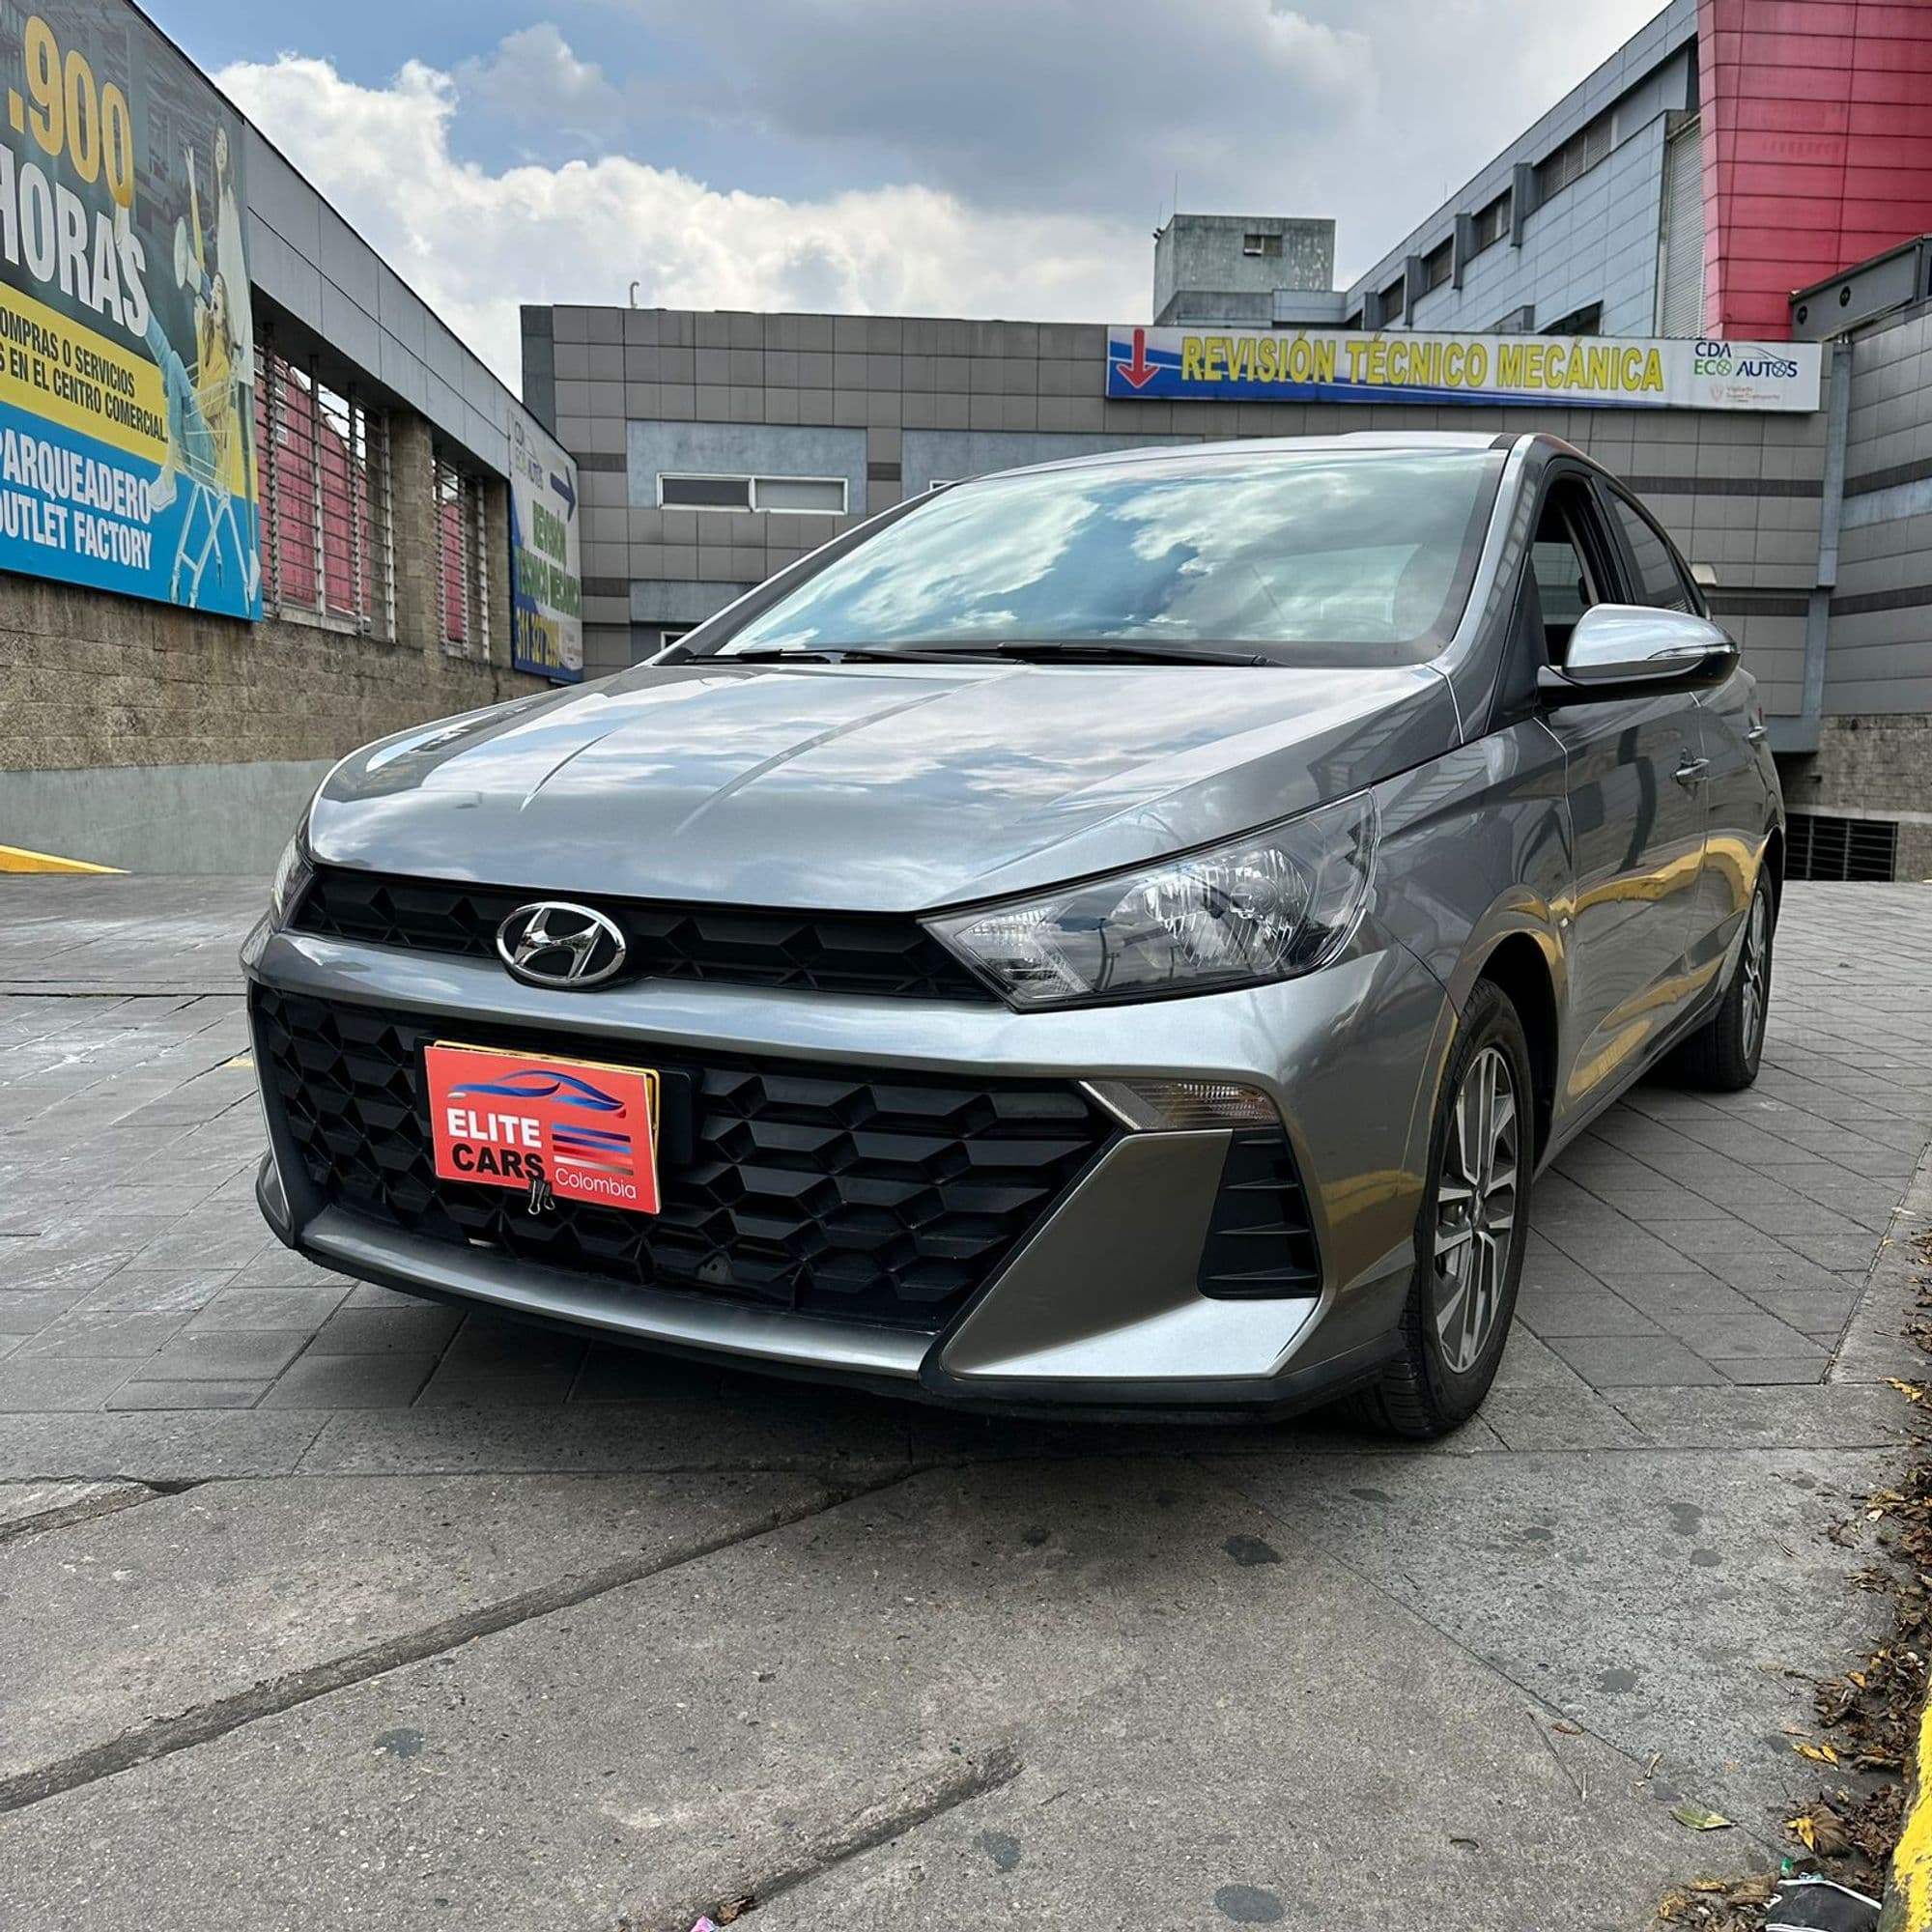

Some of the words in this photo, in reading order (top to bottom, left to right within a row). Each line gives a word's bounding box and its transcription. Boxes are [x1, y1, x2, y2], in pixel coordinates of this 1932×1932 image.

[62, 338, 71, 368] O
[74, 344, 136, 399] SERVICIOS
[1180, 329, 1335, 384] REVISIÓN
[1345, 331, 1489, 387] TÉCNICO
[1497, 338, 1664, 391] MECÁNICA
[1693, 358, 1733, 377] ECO
[1735, 360, 1799, 378] AUTOS
[1694, 341, 1732, 358] CDA
[10, 346, 29, 383] EN
[33, 357, 50, 392] EL
[52, 367, 102, 414] CENTRO
[0, 428, 152, 526] ARQUEADERO
[0, 487, 69, 550] UTLET
[73, 508, 152, 571] FACTORY
[446, 1107, 543, 1149] ELITE
[451, 1143, 546, 1181] CARS
[554, 1167, 638, 1201] Colombia
